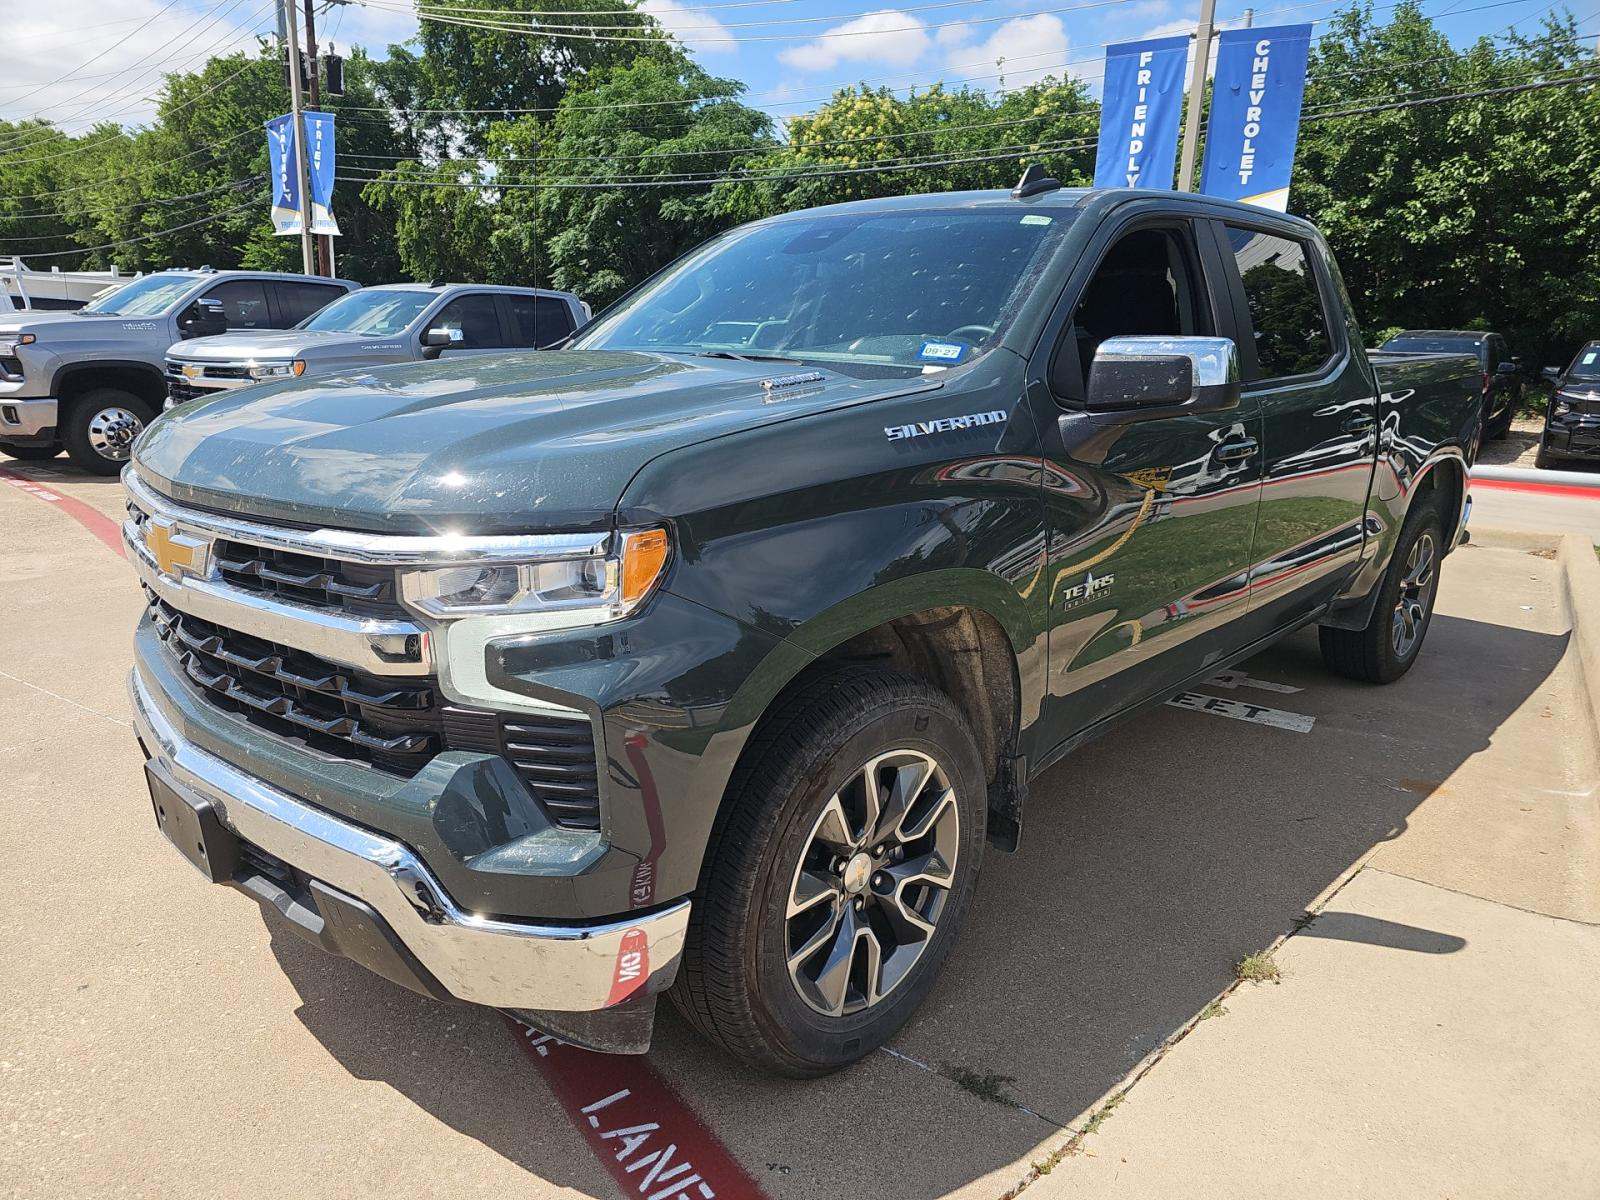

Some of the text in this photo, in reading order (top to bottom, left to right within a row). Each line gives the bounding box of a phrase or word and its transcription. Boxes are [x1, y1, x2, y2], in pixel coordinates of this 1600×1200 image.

[1125, 51, 1153, 188] FRIENDLY
[1238, 39, 1271, 185] CHEVROLET
[884, 410, 1007, 441] SILVERADO
[1063, 572, 1115, 600] TEXAS
[1170, 692, 1271, 719] EET
